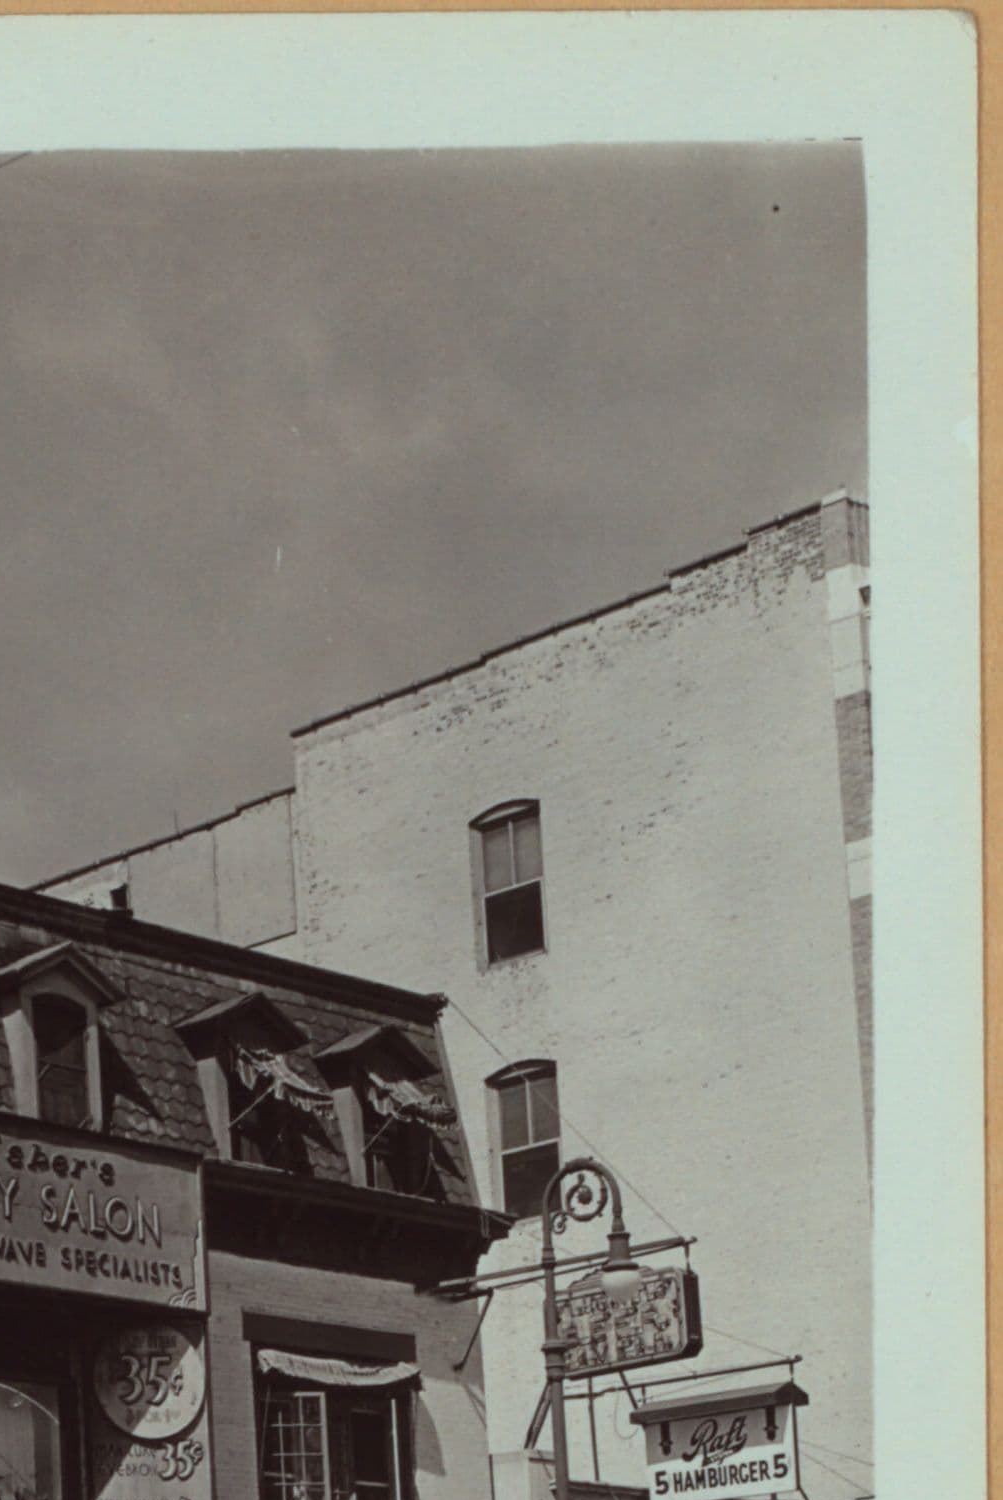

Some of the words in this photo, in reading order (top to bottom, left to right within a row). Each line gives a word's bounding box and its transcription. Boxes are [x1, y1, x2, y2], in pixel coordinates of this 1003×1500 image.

[40, 1184, 162, 1248] SALON
[60, 1246, 183, 1289] SPECIALISTS
[654, 1472, 670, 1496] 5
[673, 1460, 771, 1494] HAMBURGER
[773, 1453, 789, 1479] 5
